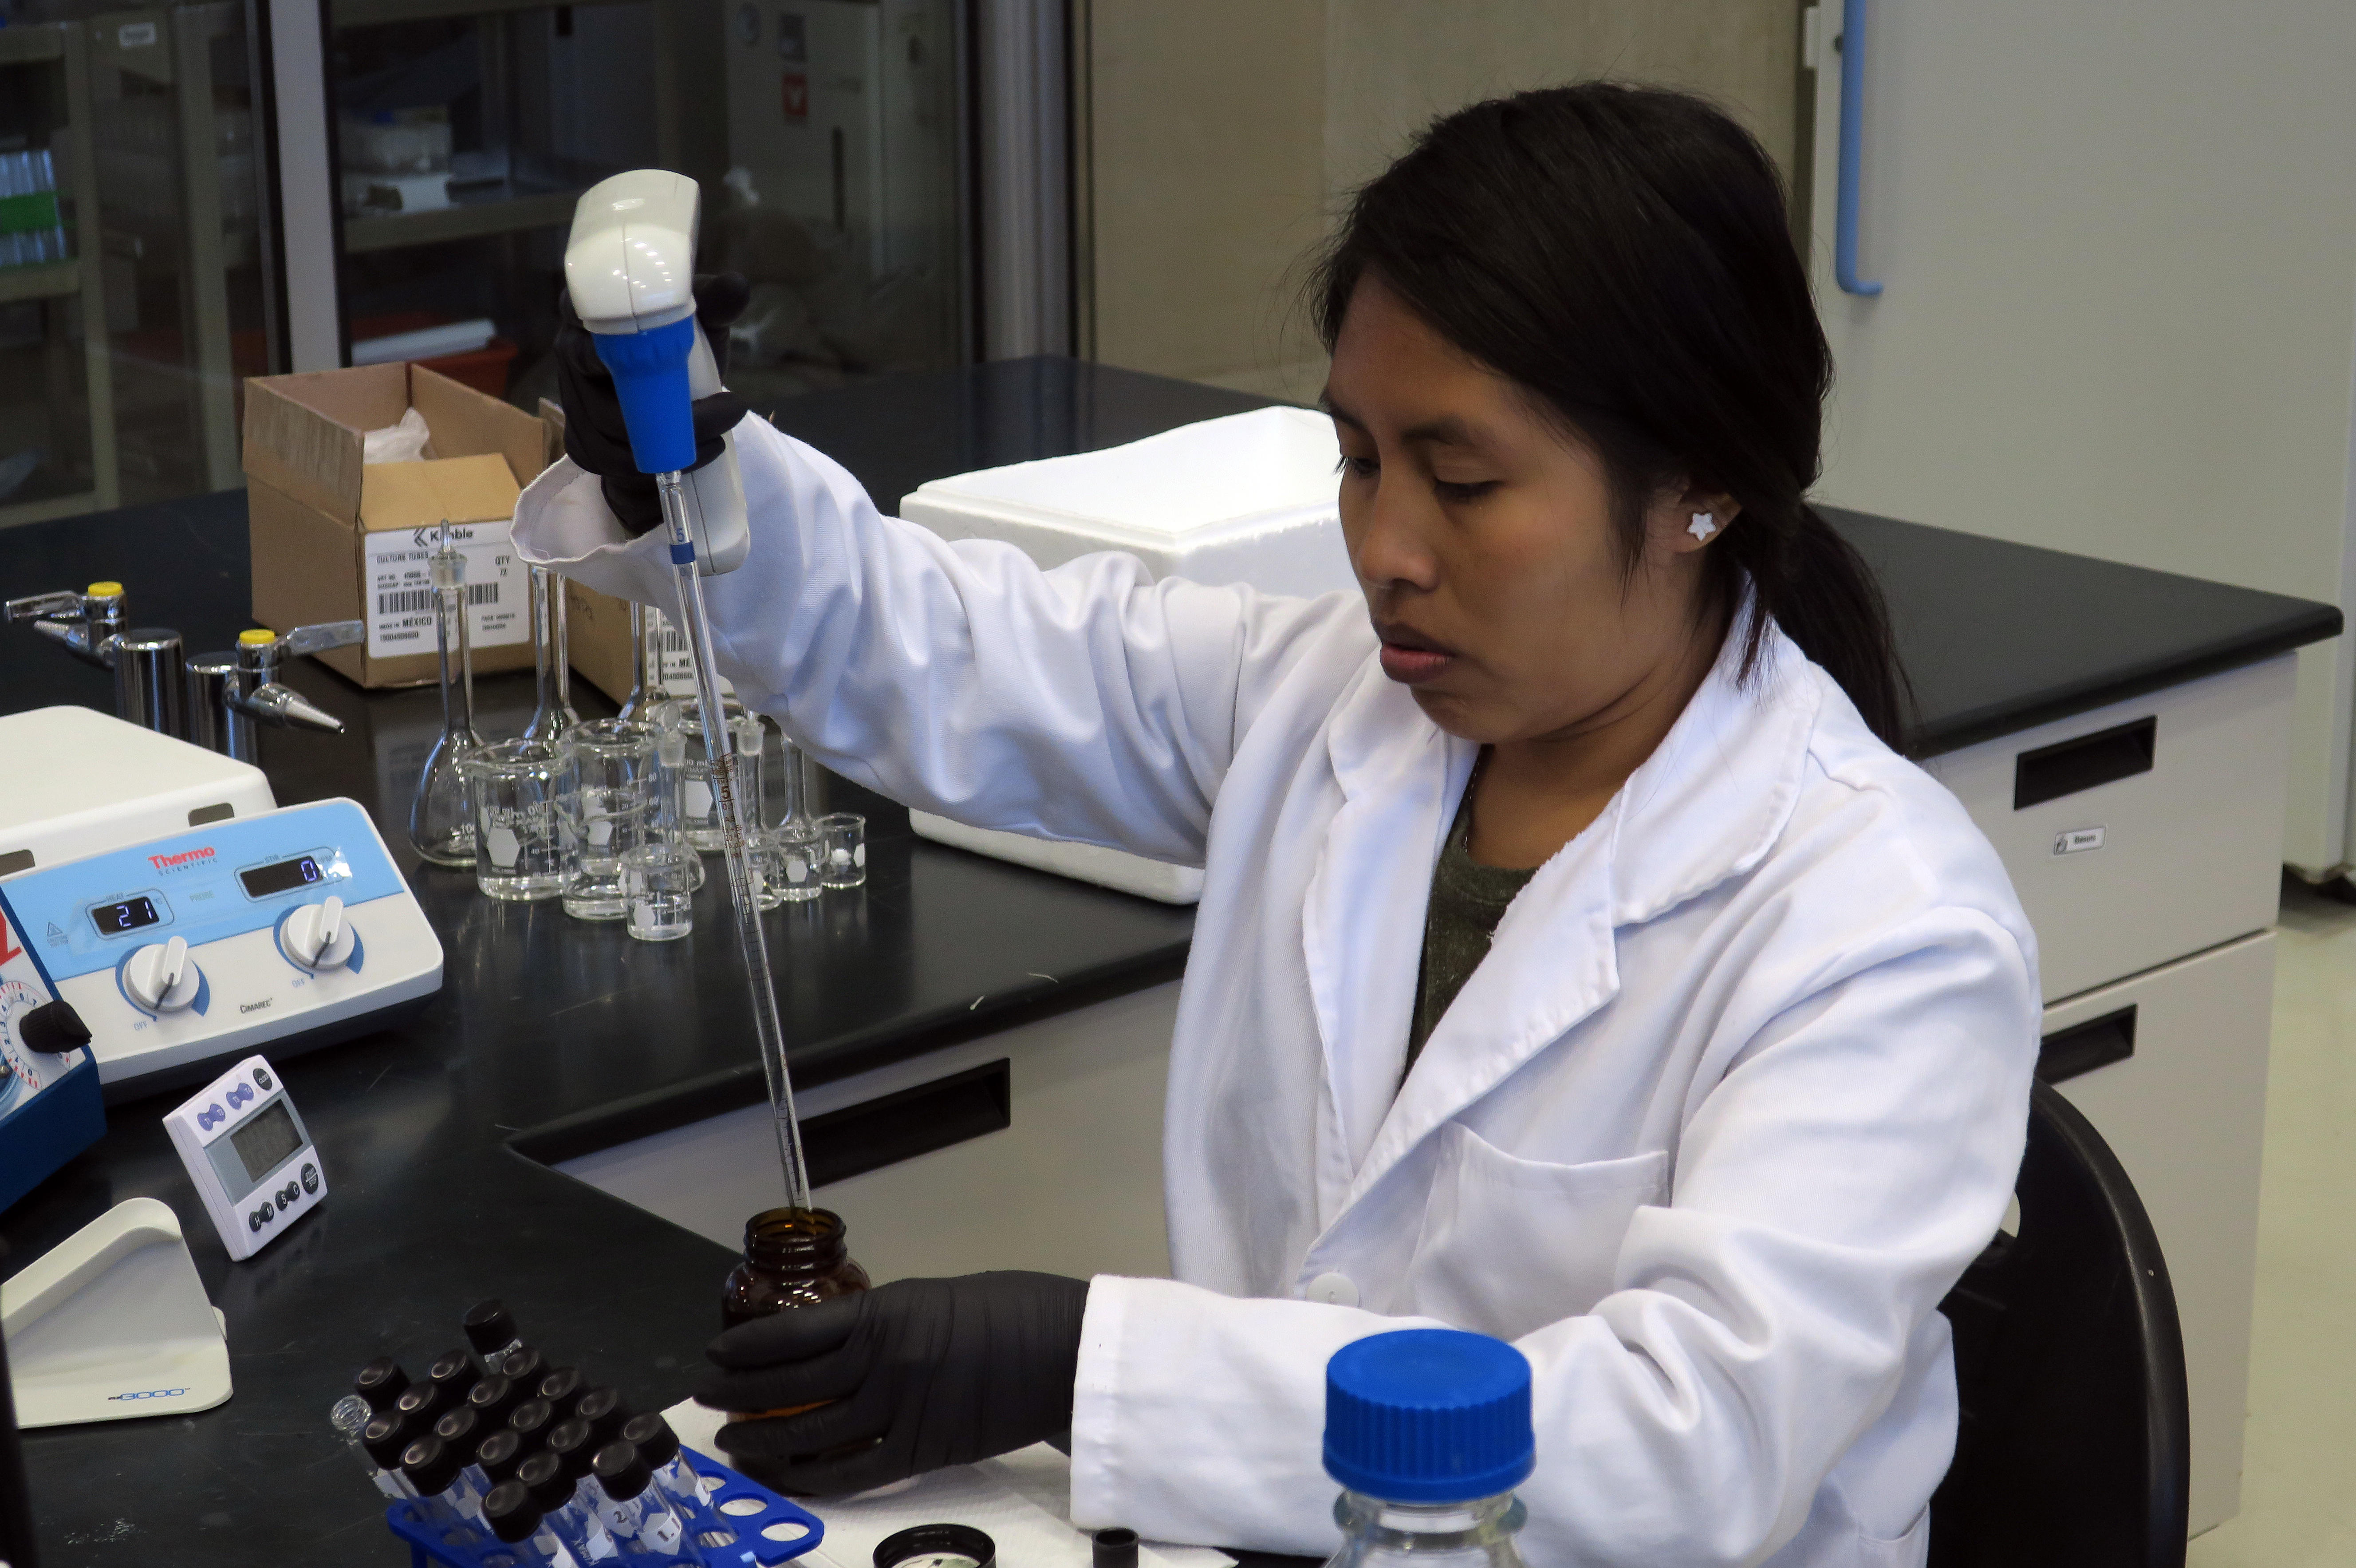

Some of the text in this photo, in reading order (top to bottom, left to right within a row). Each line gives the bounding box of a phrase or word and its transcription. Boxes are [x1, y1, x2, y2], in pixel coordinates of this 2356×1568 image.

[495, 555, 510, 565] QTY
[147, 847, 216, 869] Thermo
[158, 857, 218, 876] SCIENTIFIC
[300, 860, 318, 882] 0
[116, 901, 152, 927] 21
[292, 978, 306, 988] OFF
[133, 1021, 148, 1032] OFF
[254, 1184, 299, 1227] H M S C
